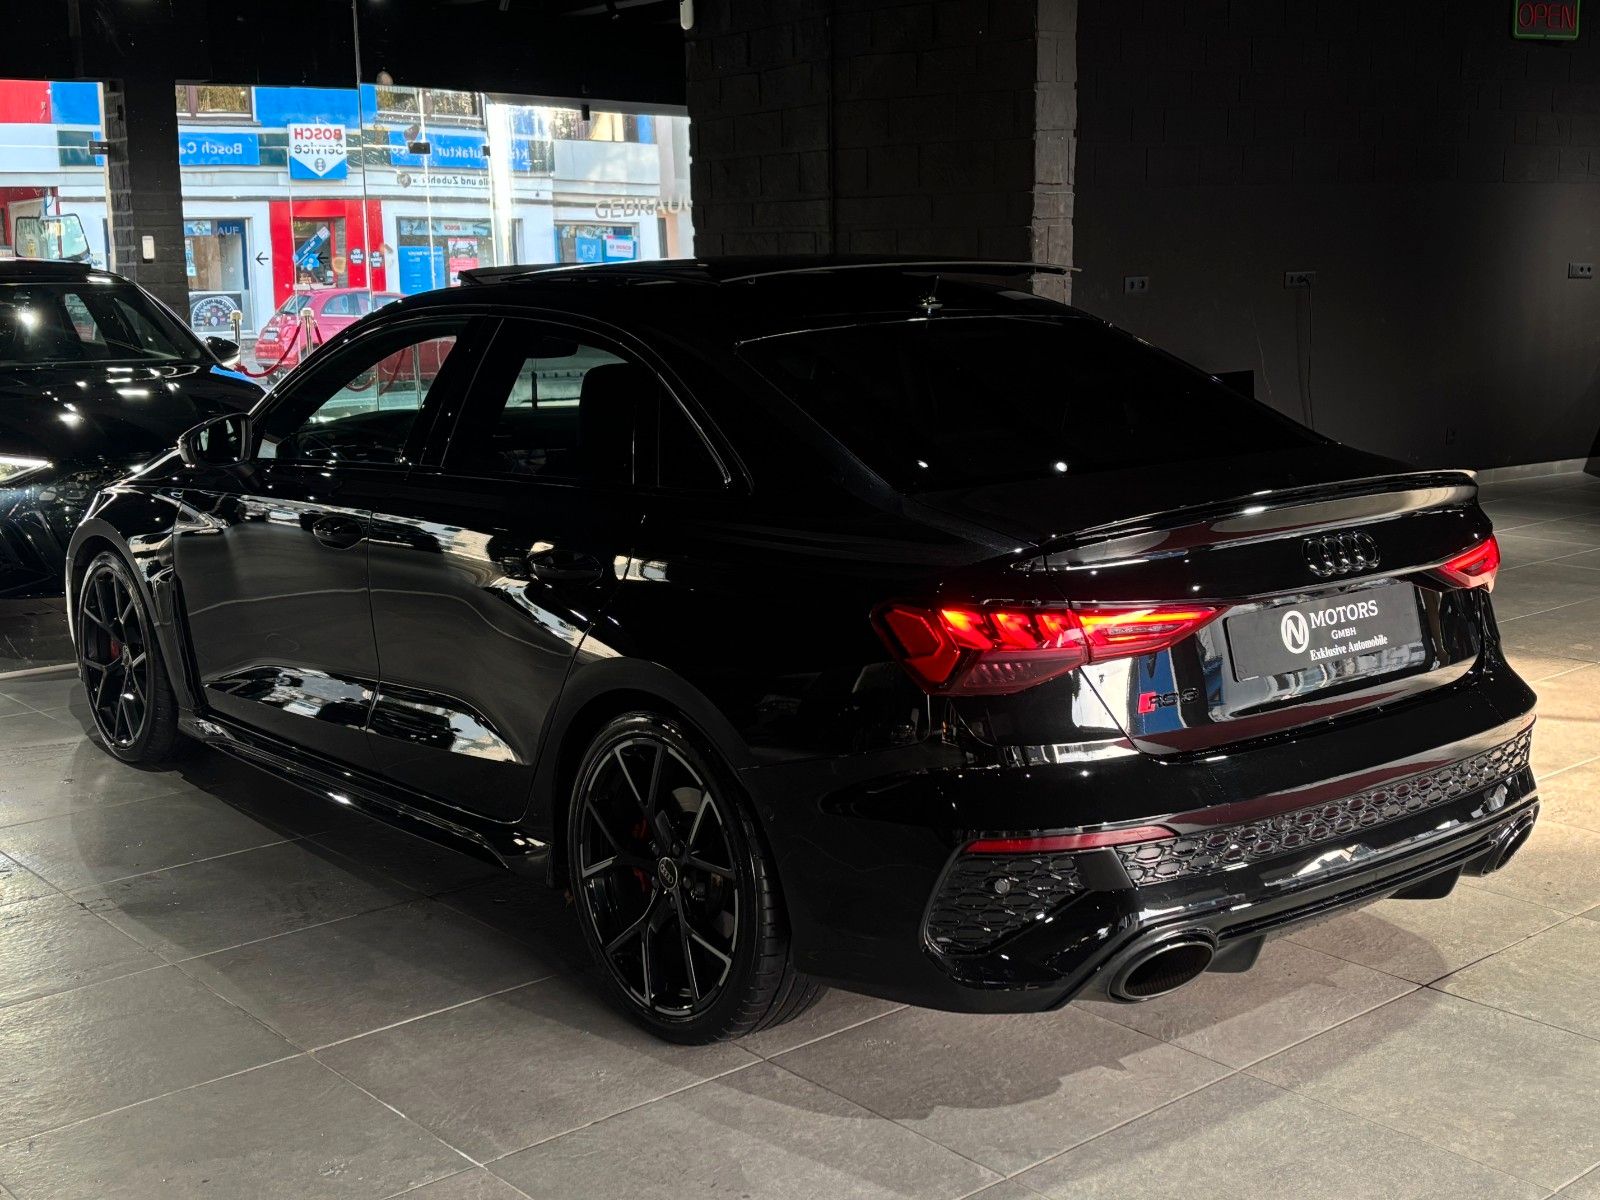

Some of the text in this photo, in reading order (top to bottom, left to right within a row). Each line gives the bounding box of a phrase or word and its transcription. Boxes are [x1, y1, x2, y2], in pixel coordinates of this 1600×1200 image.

[1520, 3, 1575, 29] OPEN
[1309, 600, 1379, 628] MOTORS
[1331, 627, 1356, 639] GMBH
[1310, 634, 1388, 661] Exklusive Automobile
